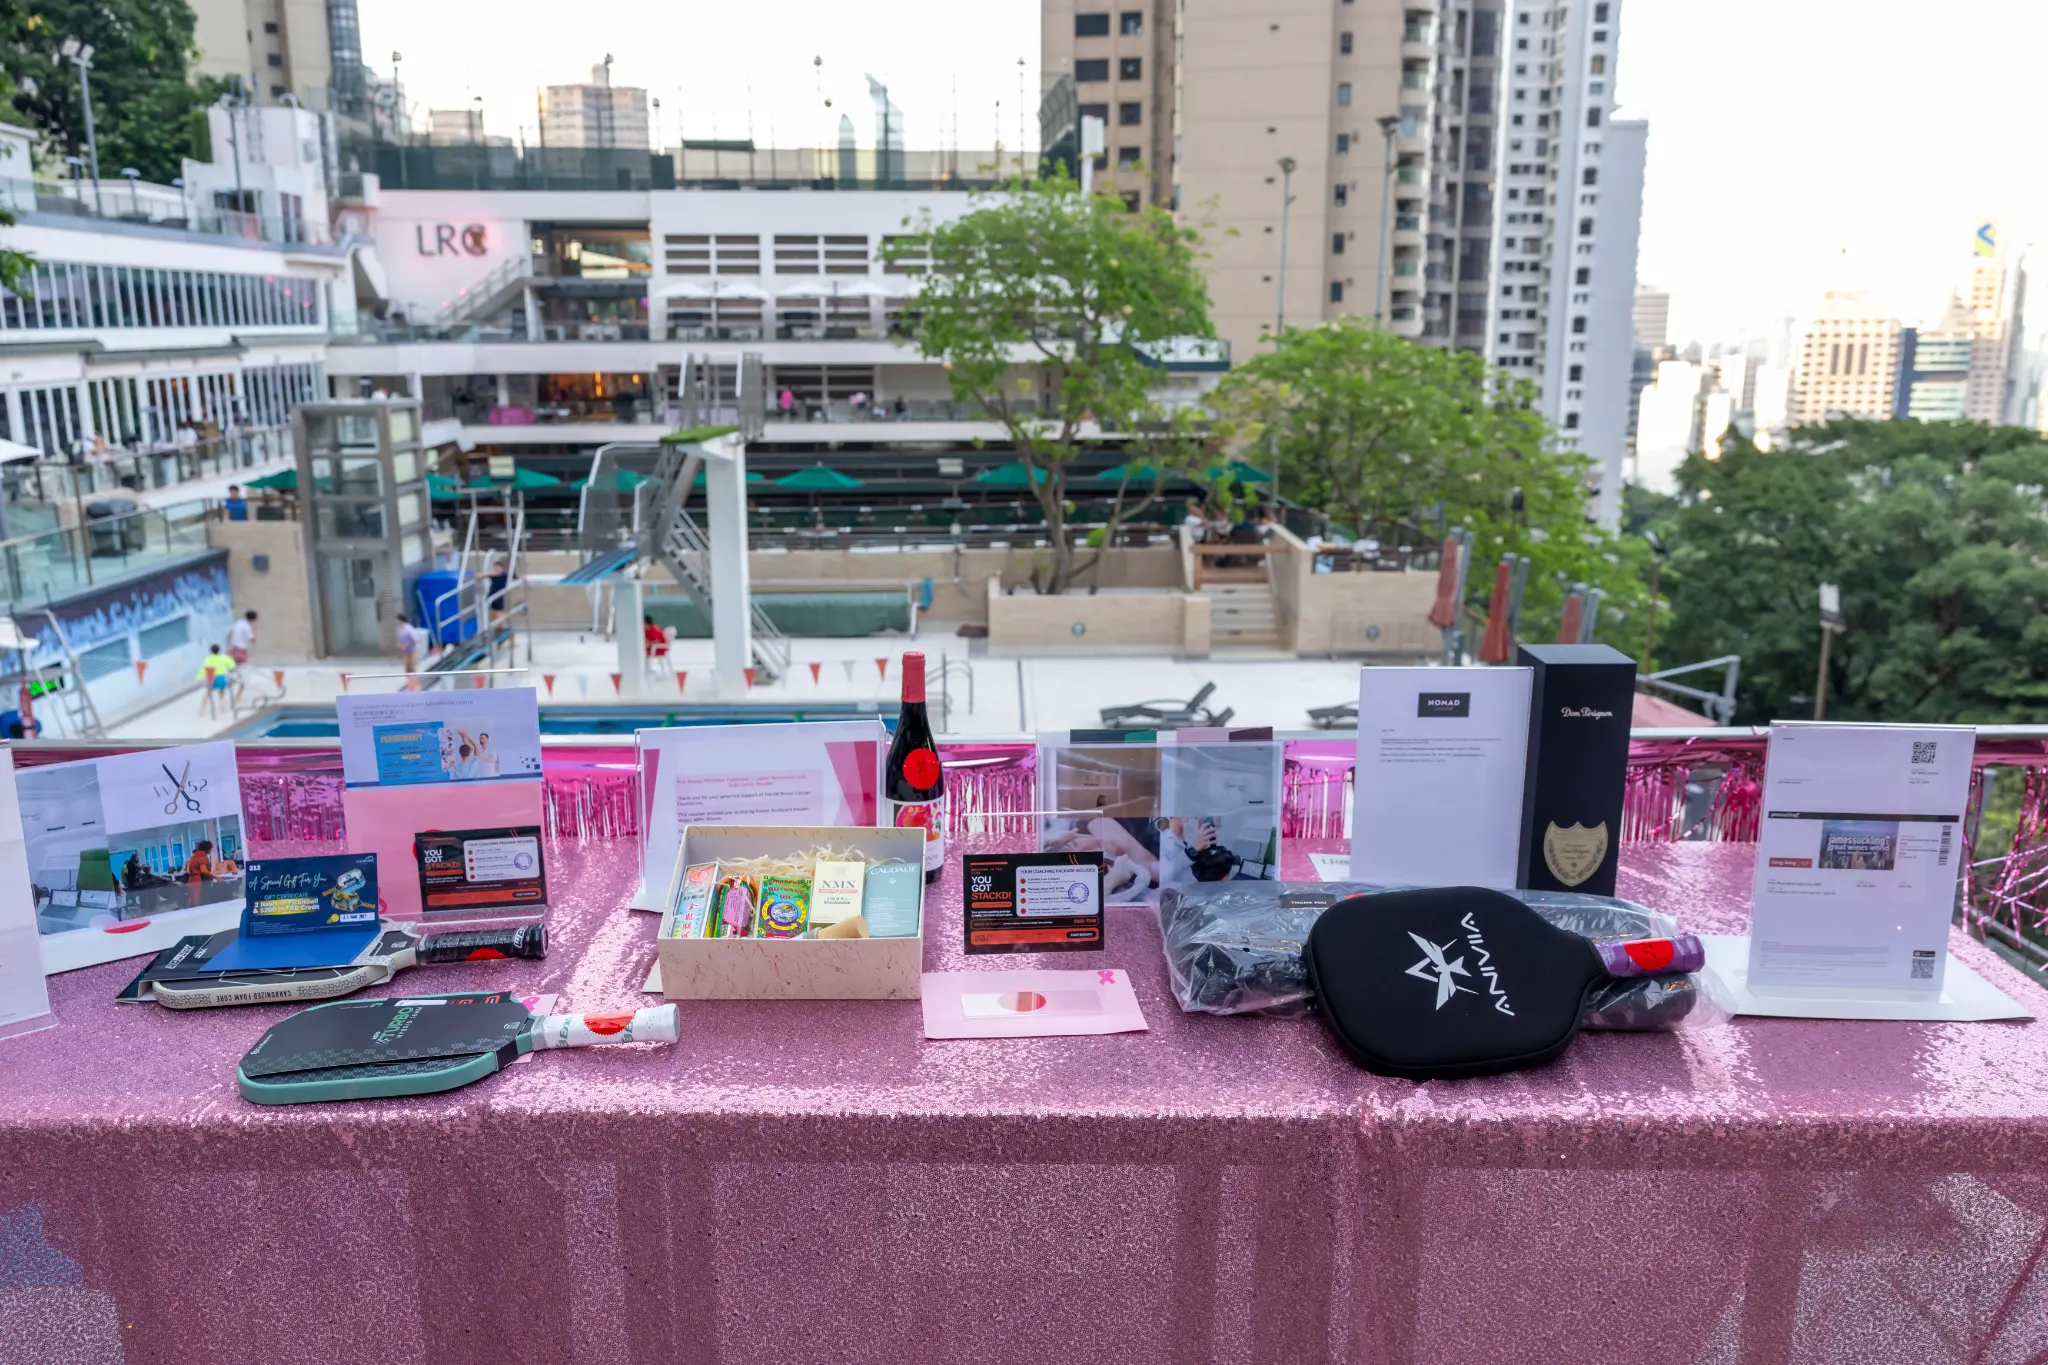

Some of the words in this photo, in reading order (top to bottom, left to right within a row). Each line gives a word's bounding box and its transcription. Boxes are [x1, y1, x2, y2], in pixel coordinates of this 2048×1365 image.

[1561, 706, 1581, 717] Dom
[1580, 706, 1613, 720] Pérignon
[424, 849, 442, 857] YOU
[424, 856, 443, 864] GOT
[425, 862, 461, 870] STACKD!
[249, 876, 258, 890] A
[260, 872, 283, 890] Special
[283, 874, 299, 888] Gift
[971, 876, 992, 884] YOU
[822, 880, 856, 889] NMN
[971, 884, 992, 892] GOT
[971, 892, 1012, 900] STACKD!
[288, 898, 319, 906] Pickleball
[300, 903, 320, 911] Credit
[216, 995, 233, 1003] CORE
[233, 993, 252, 1001] FOAM
[253, 990, 292, 1000] CARBONIZED
[378, 1007, 414, 1040] TURBO
